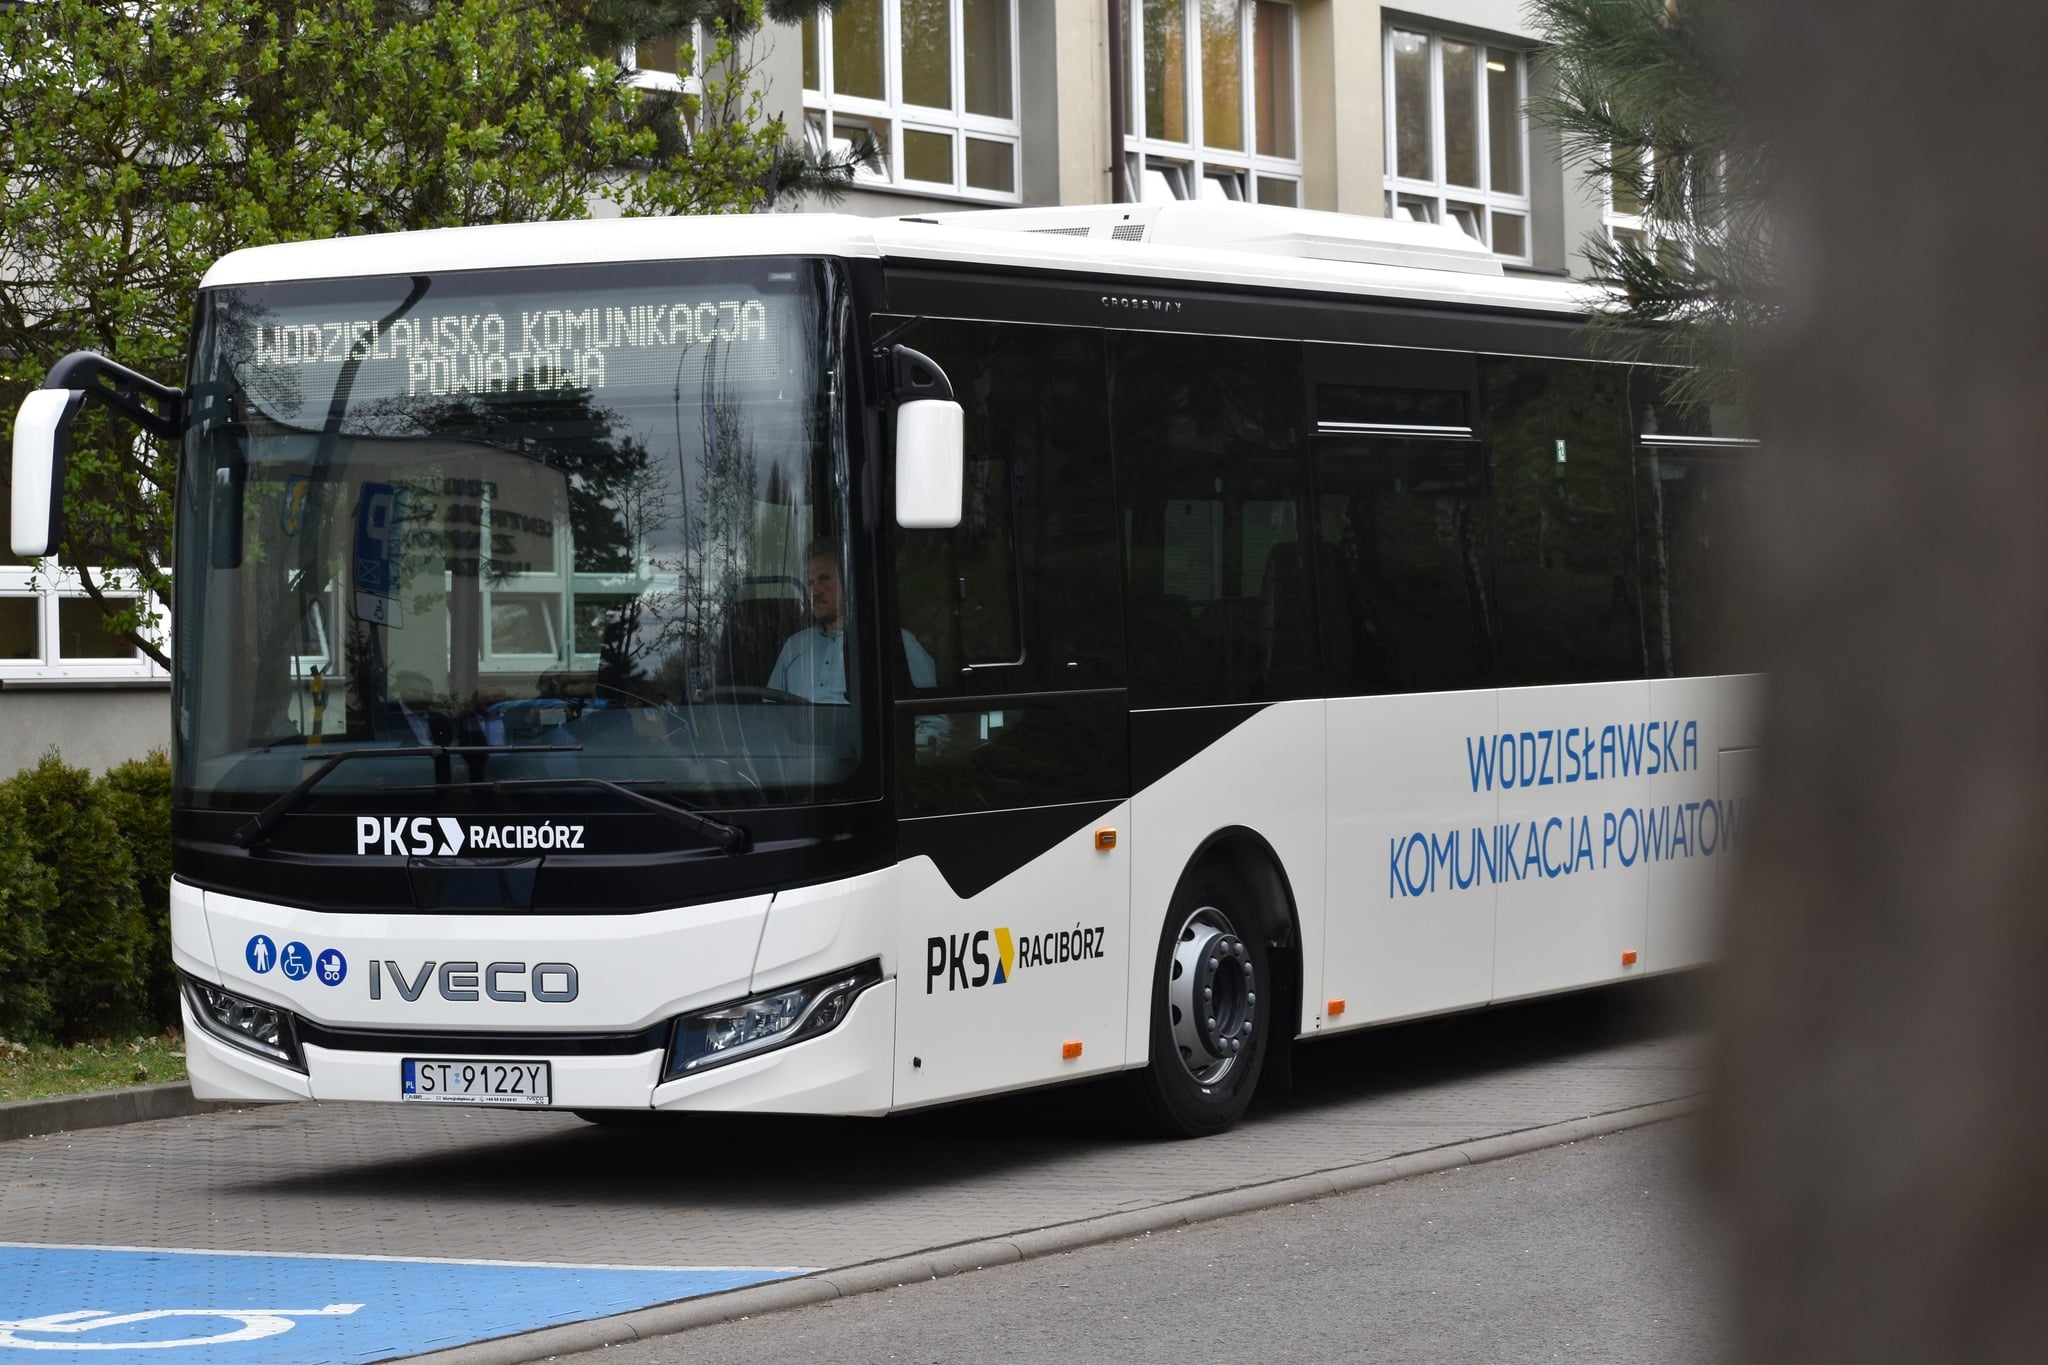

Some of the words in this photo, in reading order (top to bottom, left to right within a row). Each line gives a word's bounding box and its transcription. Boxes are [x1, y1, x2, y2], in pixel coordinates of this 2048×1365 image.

[522, 299, 766, 353] KOMUNIKACJA
[1101, 296, 1182, 313] CROSSWAY
[408, 347, 605, 397] POWIATOWA
[1466, 720, 1697, 792] WODZISŁAWSKA
[356, 816, 434, 856] PKS
[470, 820, 585, 849] RACIBÓRZ
[1390, 816, 1594, 898] KOMUNIKACJA
[1603, 798, 1748, 869] POWIATOW
[369, 960, 579, 1003] IVECO
[926, 930, 990, 995] PKS
[1019, 922, 1105, 969] RACIBÓRZ
[405, 1081, 415, 1089] PL
[421, 1064, 452, 1092] ST
[462, 1065, 541, 1095] 9122Y
